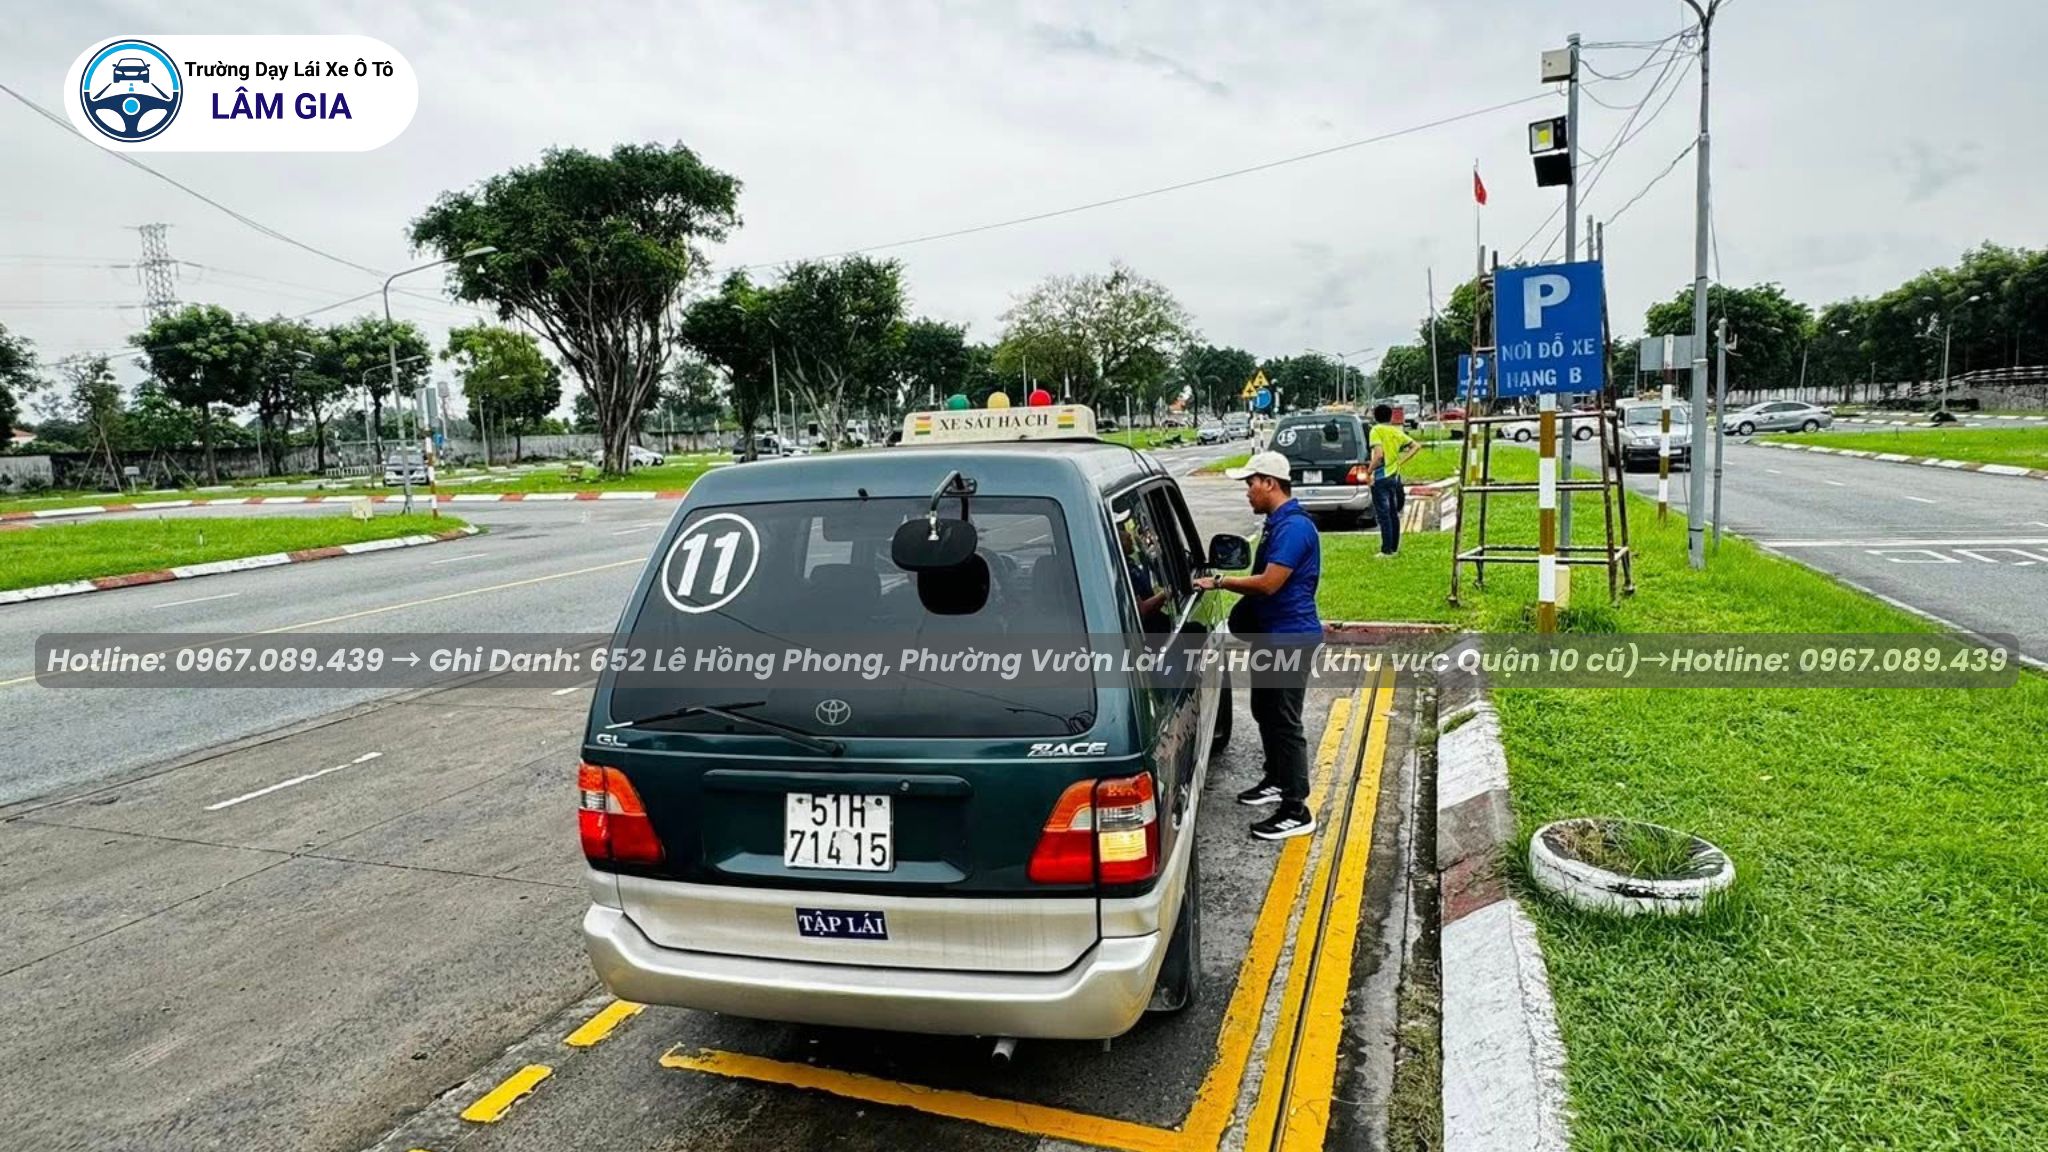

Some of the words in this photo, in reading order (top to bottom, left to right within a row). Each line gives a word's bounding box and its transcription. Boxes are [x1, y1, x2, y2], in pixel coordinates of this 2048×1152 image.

[1523, 274, 1571, 330] P
[1538, 332, 1564, 359] ĐỖ
[1571, 338, 1595, 356] XE
[1506, 368, 1557, 392] HẠNG
[1569, 366, 1582, 384] B
[940, 417, 961, 431] XE
[964, 411, 994, 430] SÁT
[1281, 431, 1294, 443] 15
[677, 531, 742, 597] 11
[596, 733, 628, 747] GL
[811, 794, 865, 828] 51H
[799, 910, 841, 936] TẬP
[846, 912, 885, 935] LÁI
